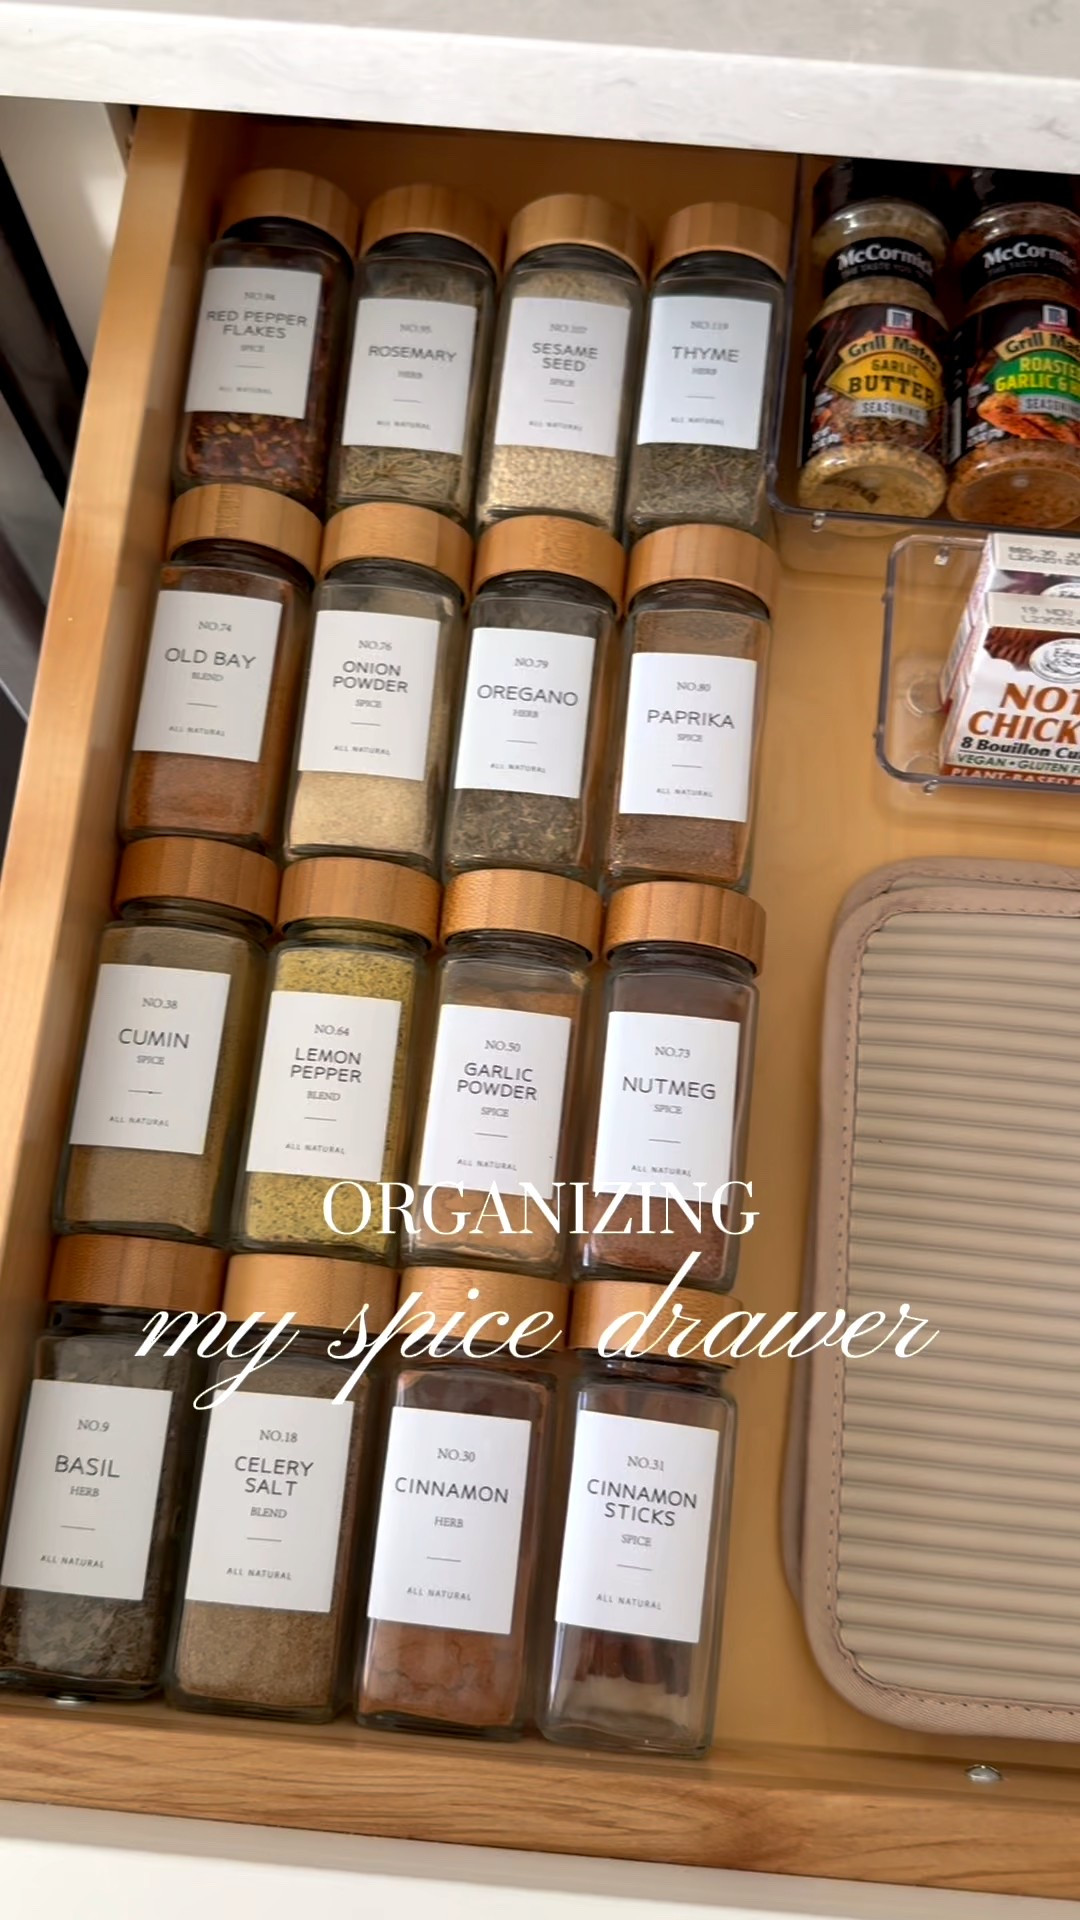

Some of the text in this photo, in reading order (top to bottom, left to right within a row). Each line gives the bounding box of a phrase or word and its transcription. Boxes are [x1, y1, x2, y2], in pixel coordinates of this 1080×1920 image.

[206, 310, 307, 327] RED PEPPER
[222, 324, 286, 339] FLAKES
[532, 342, 598, 360] SESAME
[848, 335, 886, 358] Grill
[1006, 333, 1044, 355] Grill
[368, 345, 457, 362] ROSEMARY
[672, 346, 740, 363] THYME
[542, 357, 586, 372] SEED
[871, 359, 919, 379] GARLIC
[848, 375, 934, 405] BUTTER
[995, 374, 1054, 391] GARLIC
[198, 621, 232, 632] NO.74
[358, 640, 392, 651] NO.76
[164, 647, 256, 669] OLD BAY
[514, 658, 549, 669] NO.79
[342, 660, 401, 676] ONION
[191, 672, 224, 682] BLEND
[333, 676, 408, 693] POWDER
[676, 681, 712, 692] NO.80
[477, 684, 579, 706] OREGANO
[999, 682, 1080, 716] NOT
[355, 699, 382, 708] SPICE
[512, 709, 539, 718] HERB
[647, 709, 735, 730] PAPRIKA
[187, 727, 226, 737] NATURAL
[968, 710, 1080, 745] CHICK
[677, 733, 703, 743] SPICE
[352, 746, 391, 755] NATURAL
[960, 736, 974, 749] 8
[976, 739, 1051, 757] Bouillon
[508, 763, 546, 774] NATURAL
[958, 754, 1008, 766] VEGAN
[1017, 760, 1070, 774] GLUTEN
[675, 788, 713, 797] NATURAL
[141, 997, 178, 1010] NO.38
[314, 1024, 350, 1037] NO.64
[118, 1028, 190, 1049] CUMIN
[484, 1040, 521, 1052] NO.50
[295, 1047, 362, 1066] LEMON
[654, 1046, 691, 1059] NO.73
[136, 1055, 165, 1066] SPICE
[290, 1064, 363, 1083] PEPPER
[464, 1062, 533, 1082] GARLIC
[457, 1079, 538, 1100] POWDER
[622, 1076, 716, 1100] NUTMEG
[306, 1090, 341, 1102] BLEND
[480, 1106, 509, 1118] SPICE
[653, 1104, 683, 1115] SPICE
[109, 1116, 170, 1127] ALL NATURAL
[285, 1142, 346, 1155] ALL NATURAL
[457, 1158, 518, 1171] ALL NATURAL
[631, 1165, 692, 1177] ALL NATURAL
[77, 1419, 110, 1432] NO.9
[259, 1429, 298, 1443] NO.18
[437, 1448, 476, 1462] NO.30
[54, 1454, 120, 1478] BASIL
[234, 1456, 314, 1477] CELERY
[627, 1455, 665, 1471] NO.31
[70, 1486, 100, 1497] HERB
[244, 1477, 298, 1496] SALT
[395, 1477, 509, 1504] CINNAMON
[587, 1478, 697, 1509] CINNAMON
[250, 1506, 287, 1519] BLEND
[605, 1502, 676, 1527] STICKS
[434, 1516, 464, 1528] HERB
[621, 1534, 652, 1547] SPICE
[40, 1554, 105, 1569] ALL NATURAL
[226, 1567, 292, 1581] ALL NATURAL
[407, 1586, 472, 1601] ALL NATURAL
[596, 1593, 662, 1610] ALL NATURAL
